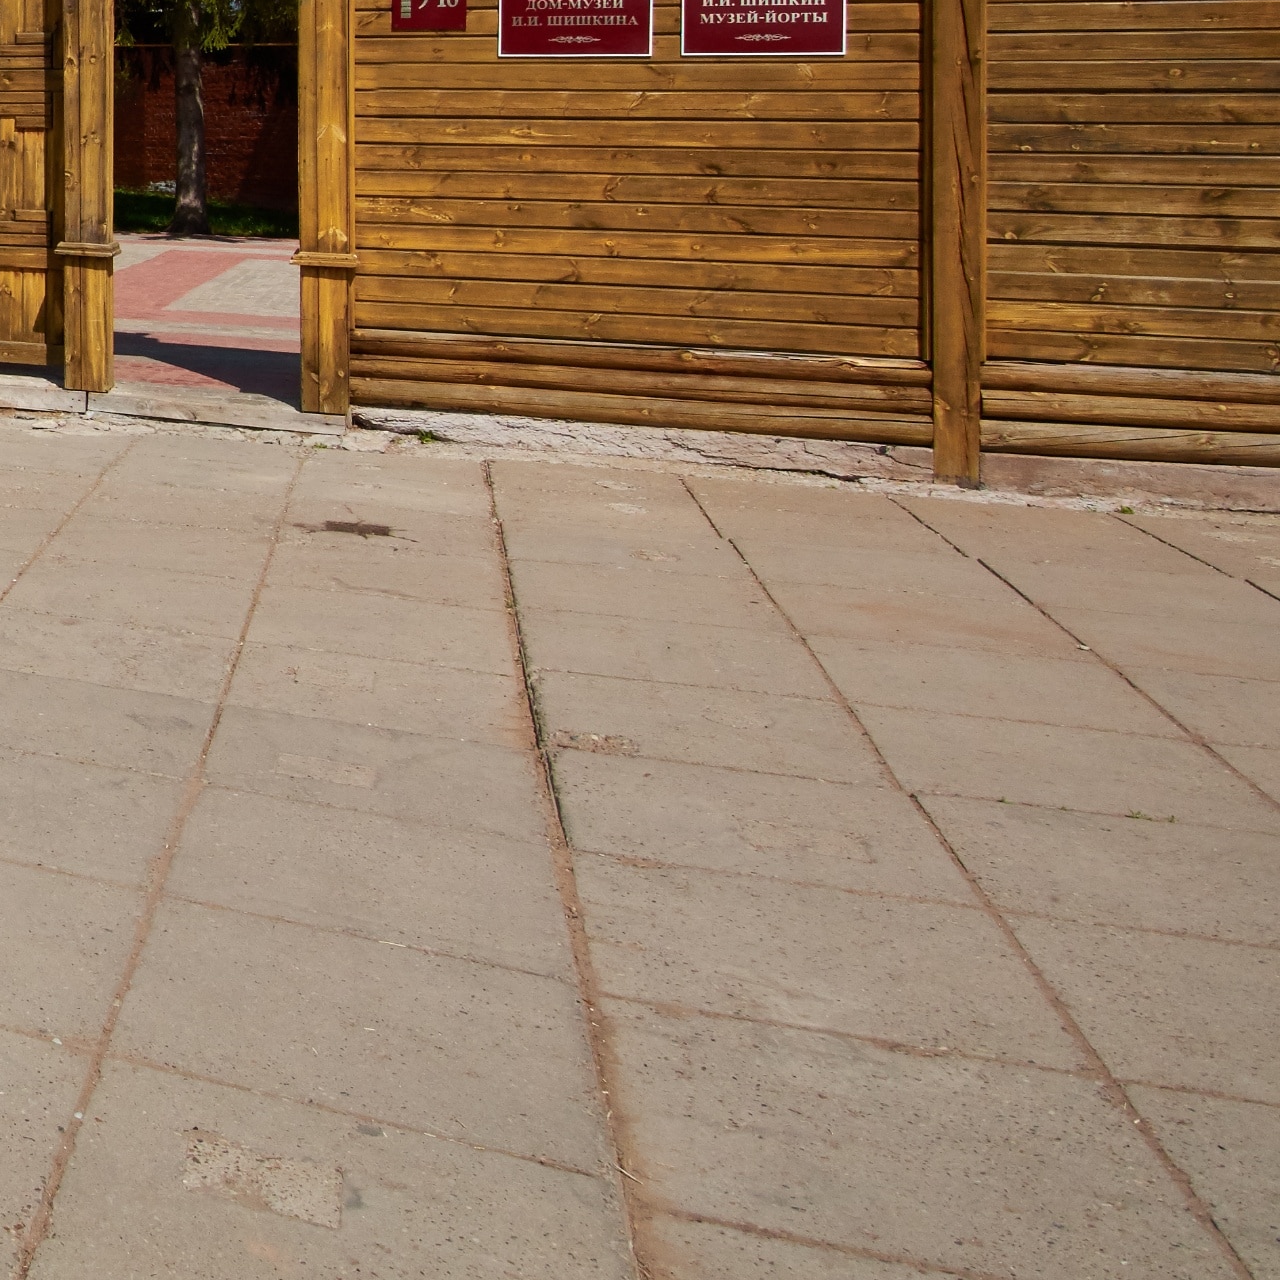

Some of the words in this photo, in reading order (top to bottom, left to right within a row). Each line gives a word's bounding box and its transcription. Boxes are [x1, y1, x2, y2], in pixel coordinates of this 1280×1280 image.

[511, 16, 543, 27] И.И.
[547, 15, 639, 27] ШИШКИНА
[700, 11, 828, 24] МУЗЕЙ-ЙОРТЫ
